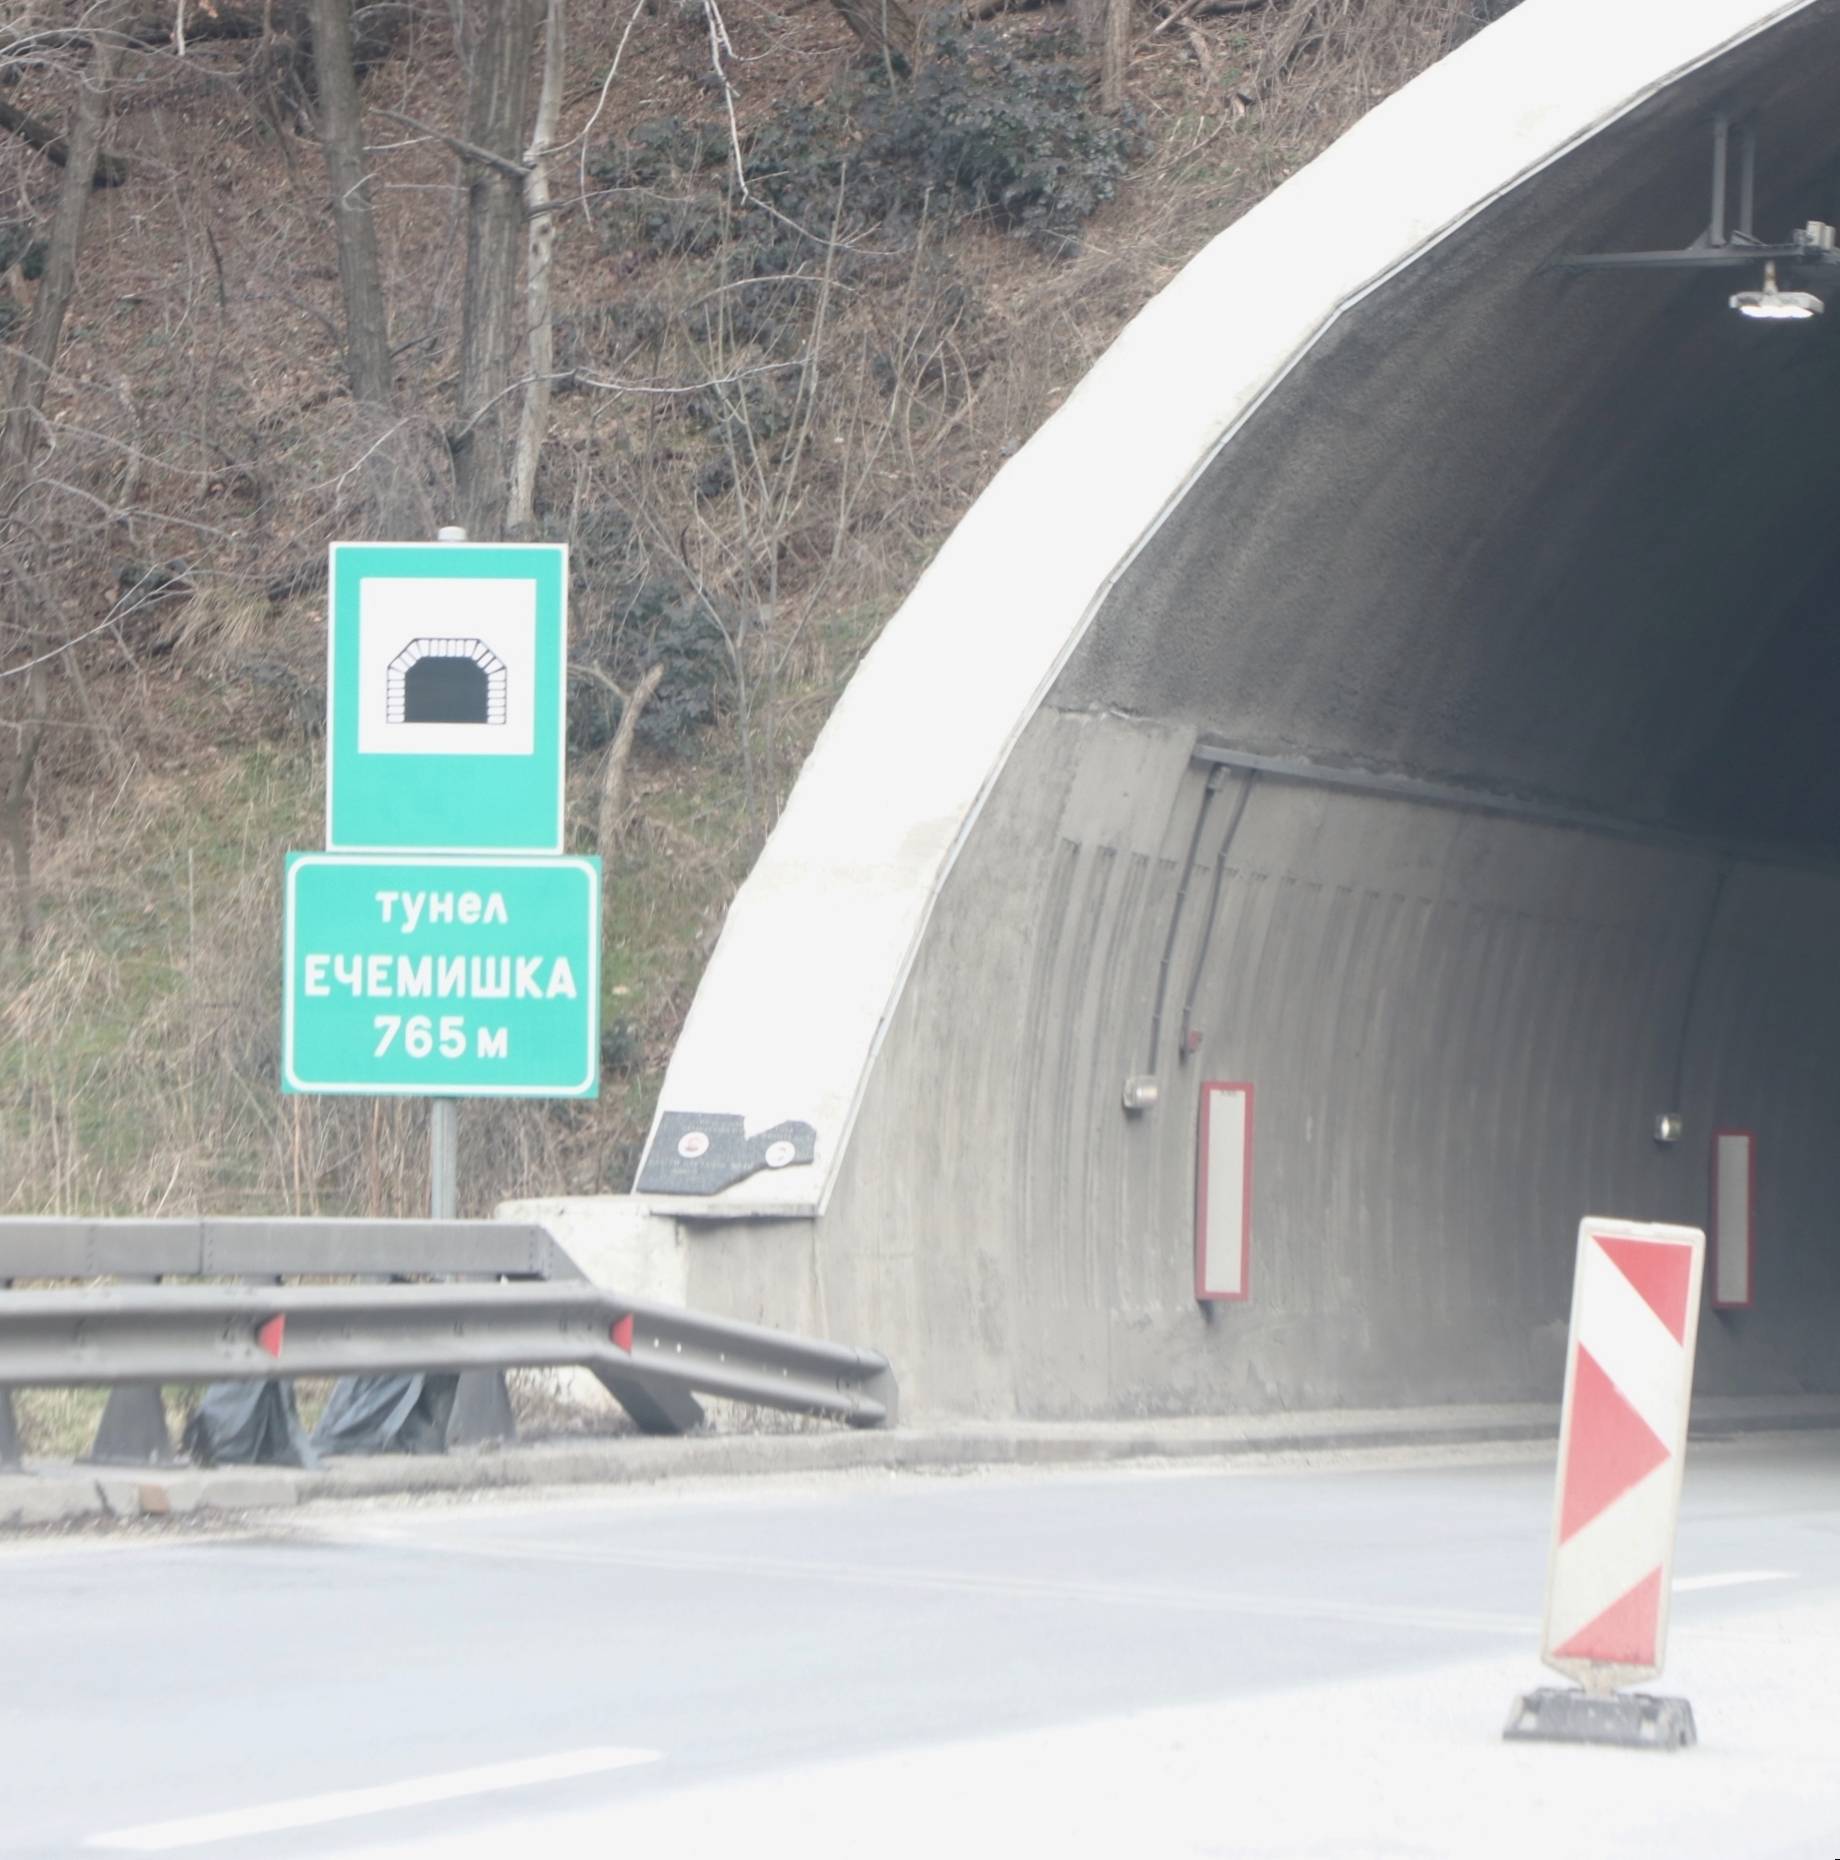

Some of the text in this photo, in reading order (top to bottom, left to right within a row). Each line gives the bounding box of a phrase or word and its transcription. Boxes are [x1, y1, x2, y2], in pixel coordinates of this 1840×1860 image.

[375, 891, 508, 933] тунел
[304, 954, 577, 998] ЕЧЕМИШКА
[374, 1015, 508, 1058] 765 м
